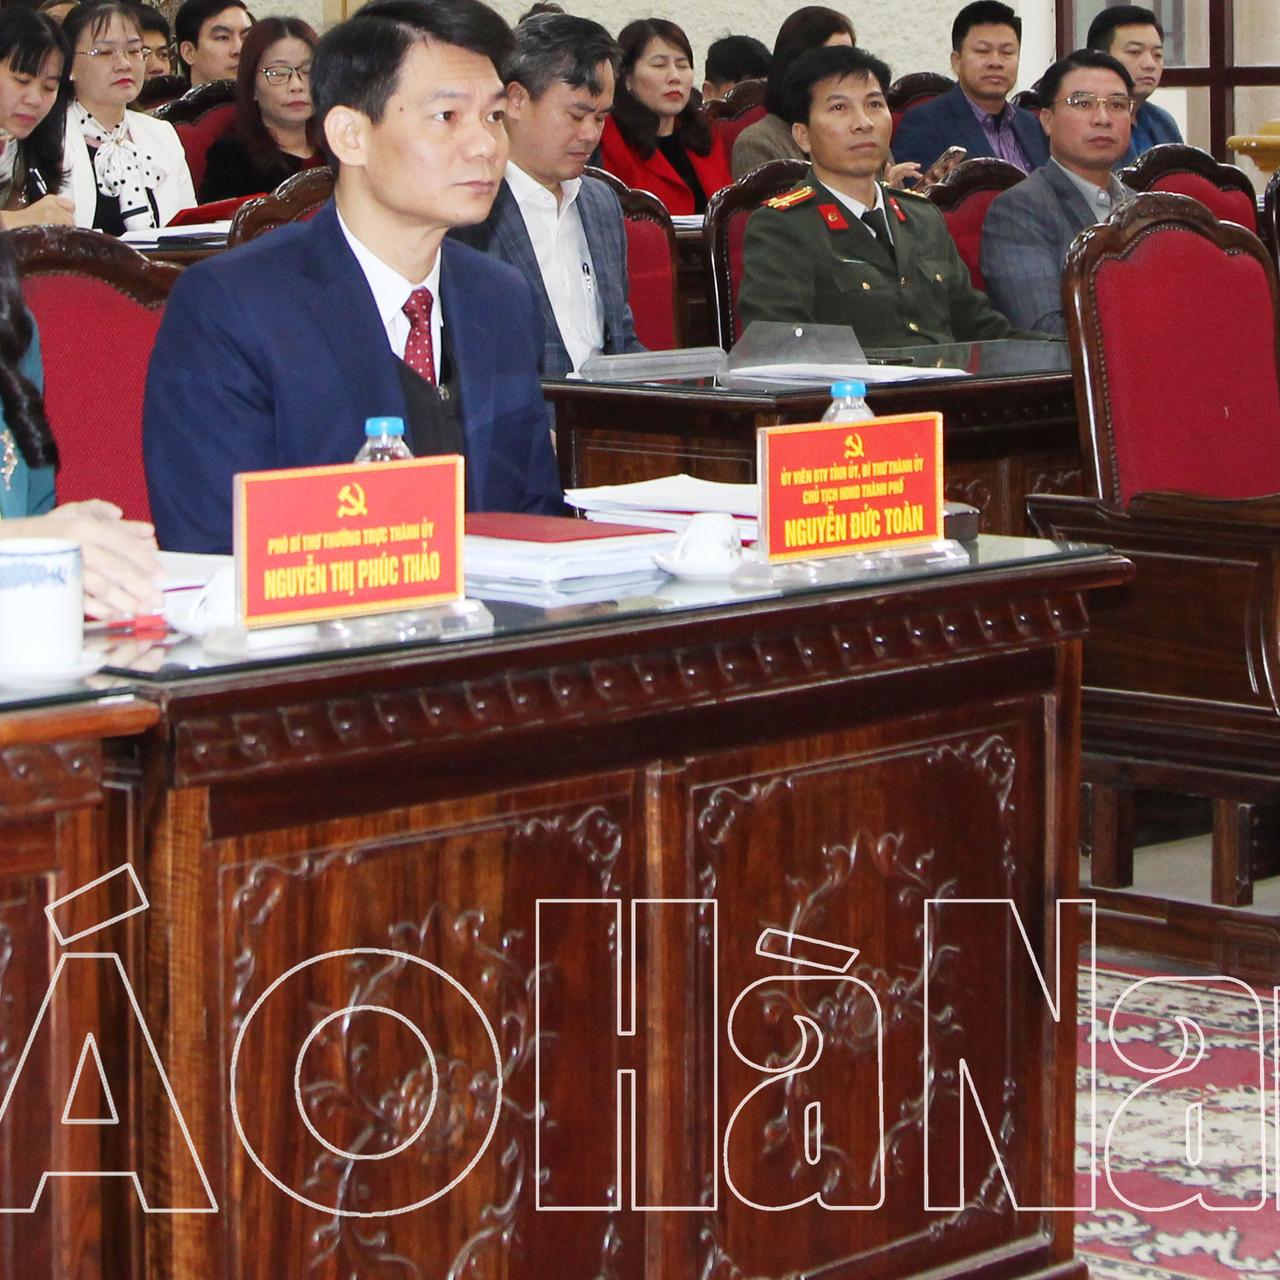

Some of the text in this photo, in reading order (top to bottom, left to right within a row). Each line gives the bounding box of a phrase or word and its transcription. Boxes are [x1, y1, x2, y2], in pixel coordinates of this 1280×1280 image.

[785, 501, 923, 547] NGUYỄN ĐỨC TOÀN
[264, 540, 440, 599] NGUYỄN THỊ PHÚC THẢO
